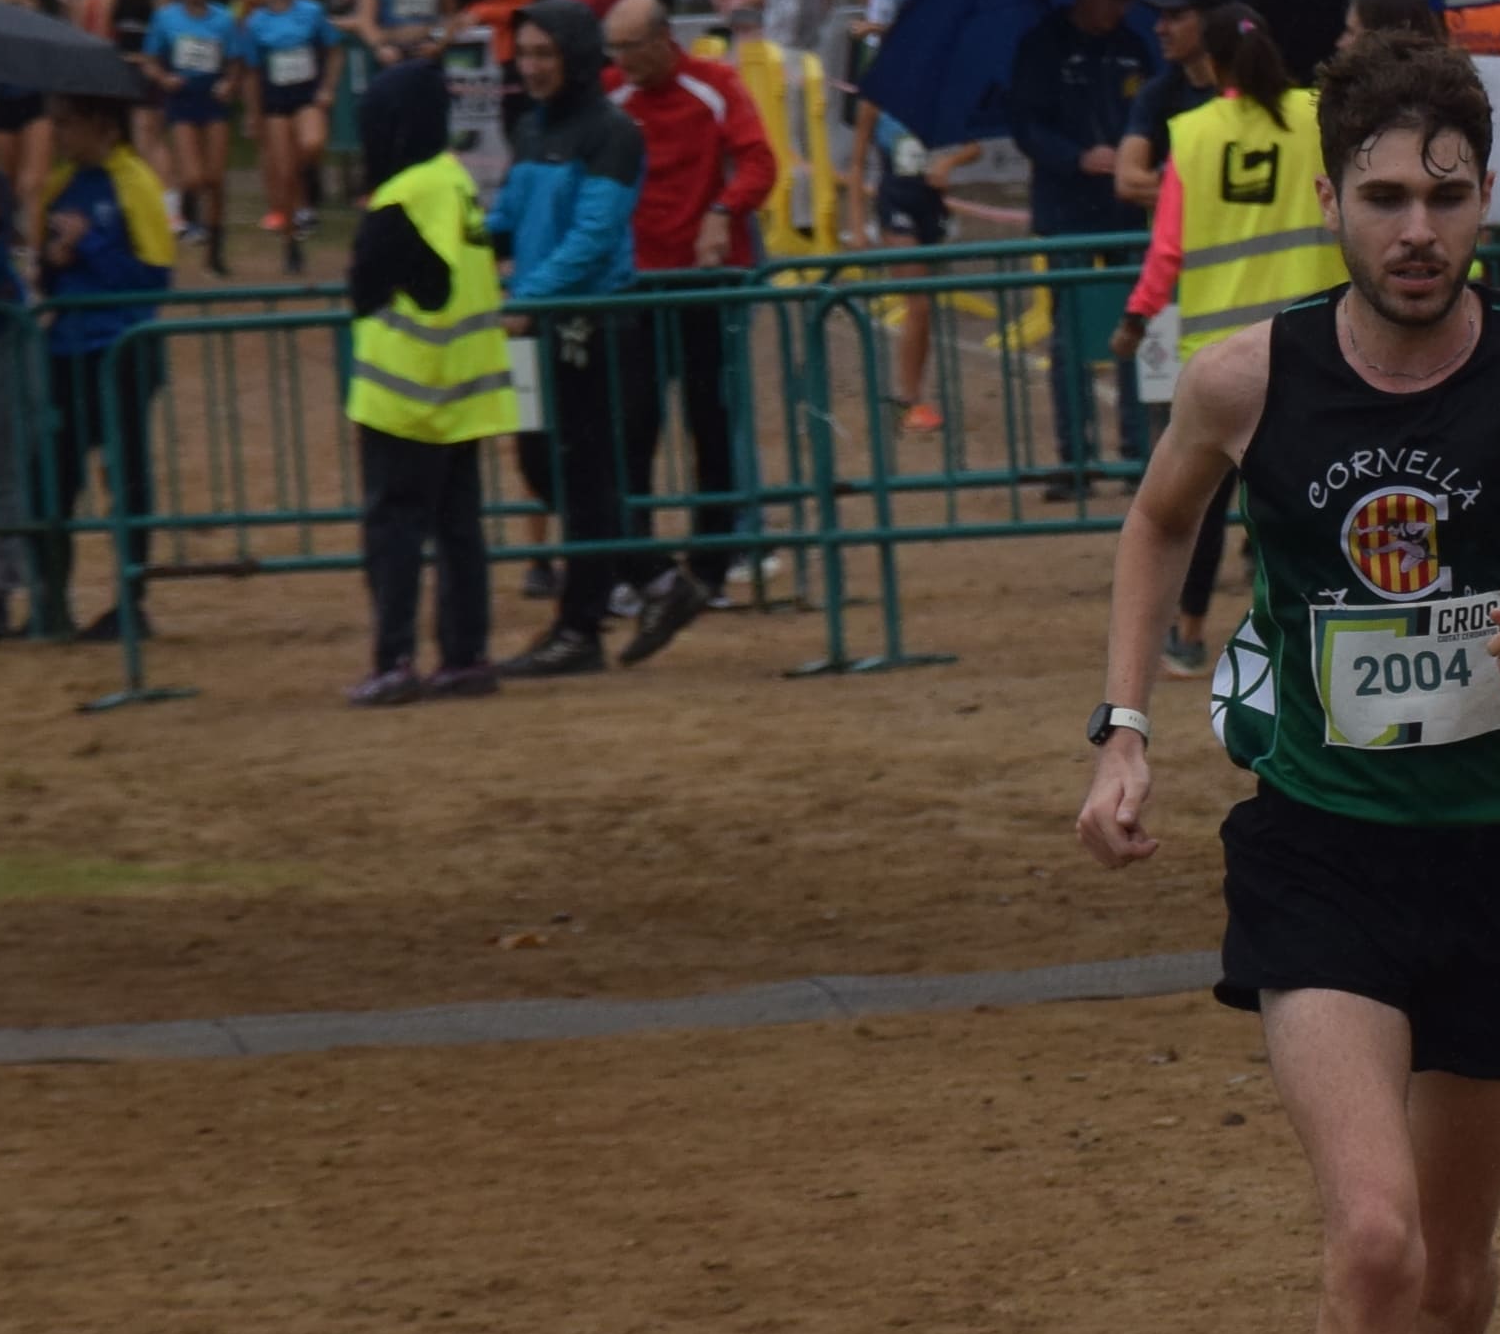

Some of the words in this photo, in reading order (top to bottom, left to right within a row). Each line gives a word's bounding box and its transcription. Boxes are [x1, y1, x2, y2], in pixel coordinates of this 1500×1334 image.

[1308, 447, 1483, 511] CORNELLÀ
[1437, 600, 1499, 635] CROS
[1353, 647, 1473, 697] 2004
